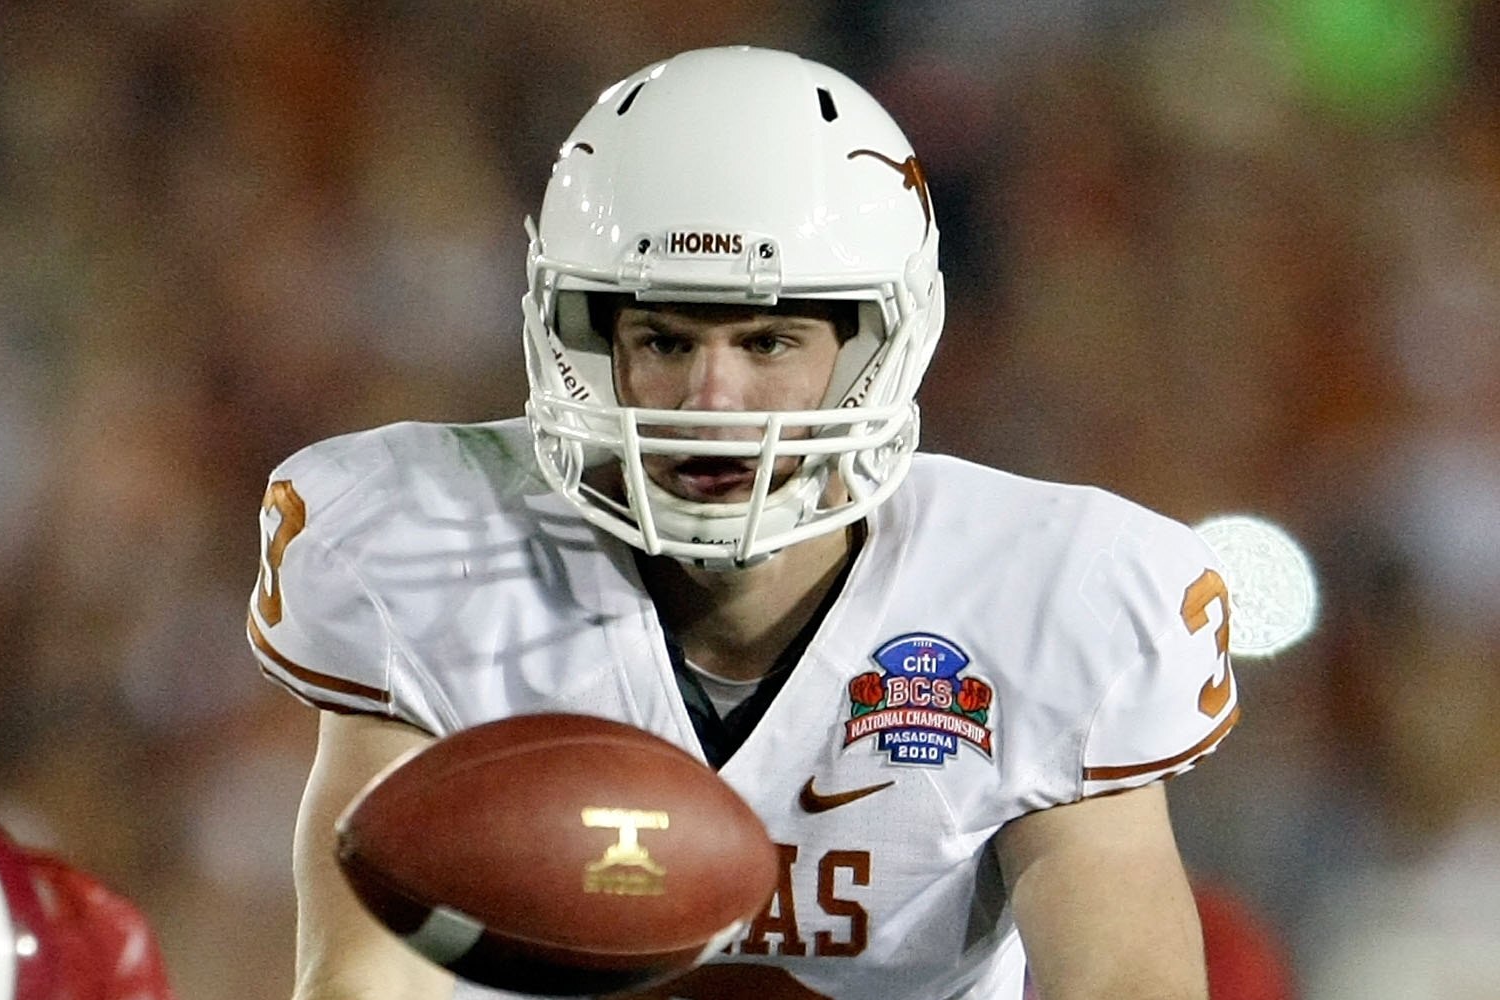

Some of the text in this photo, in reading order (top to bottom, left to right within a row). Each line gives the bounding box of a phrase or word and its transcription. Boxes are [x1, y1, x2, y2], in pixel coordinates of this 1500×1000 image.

[671, 232, 743, 254] HORNS
[903, 653, 937, 673] citi
[887, 676, 953, 708] BCS
[851, 710, 986, 743] NATIONAL CHAMPIONSHIP
[885, 731, 953, 749] PASADENA
[898, 746, 938, 760] 2010
[724, 843, 871, 957] AS
